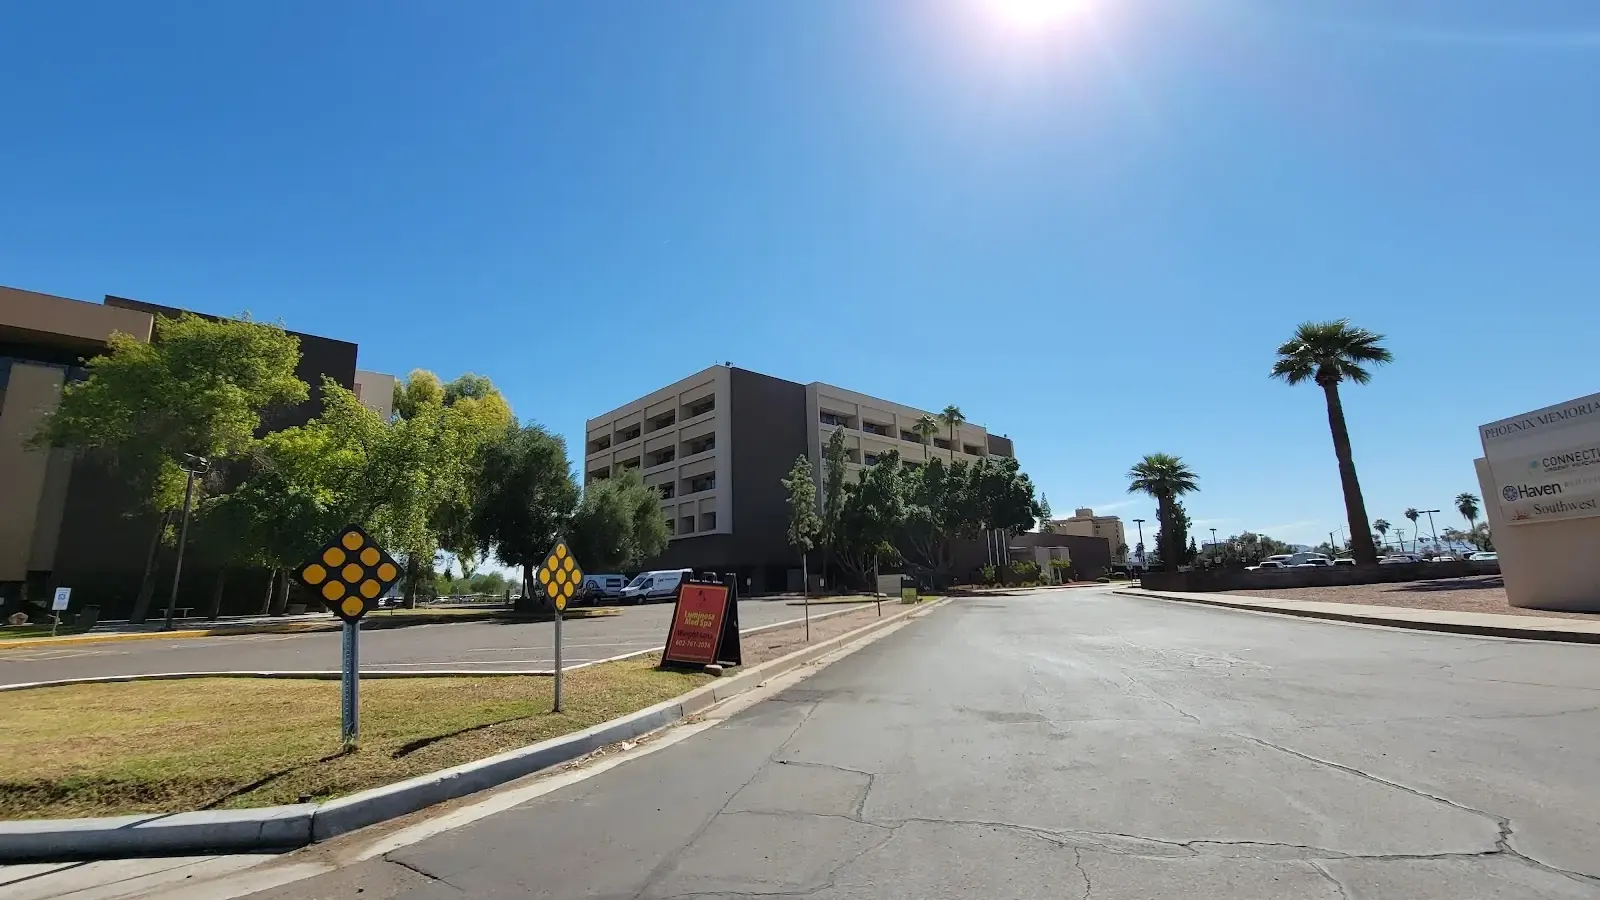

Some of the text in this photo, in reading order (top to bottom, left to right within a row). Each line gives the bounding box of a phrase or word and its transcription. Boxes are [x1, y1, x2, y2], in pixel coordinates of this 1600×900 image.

[1485, 417, 1535, 439] PHOENIX
[1517, 483, 1562, 499] Haven
[1533, 499, 1597, 515] Southwest
[684, 610, 715, 620] Luminosa
[684, 618, 712, 628] Med Spa
